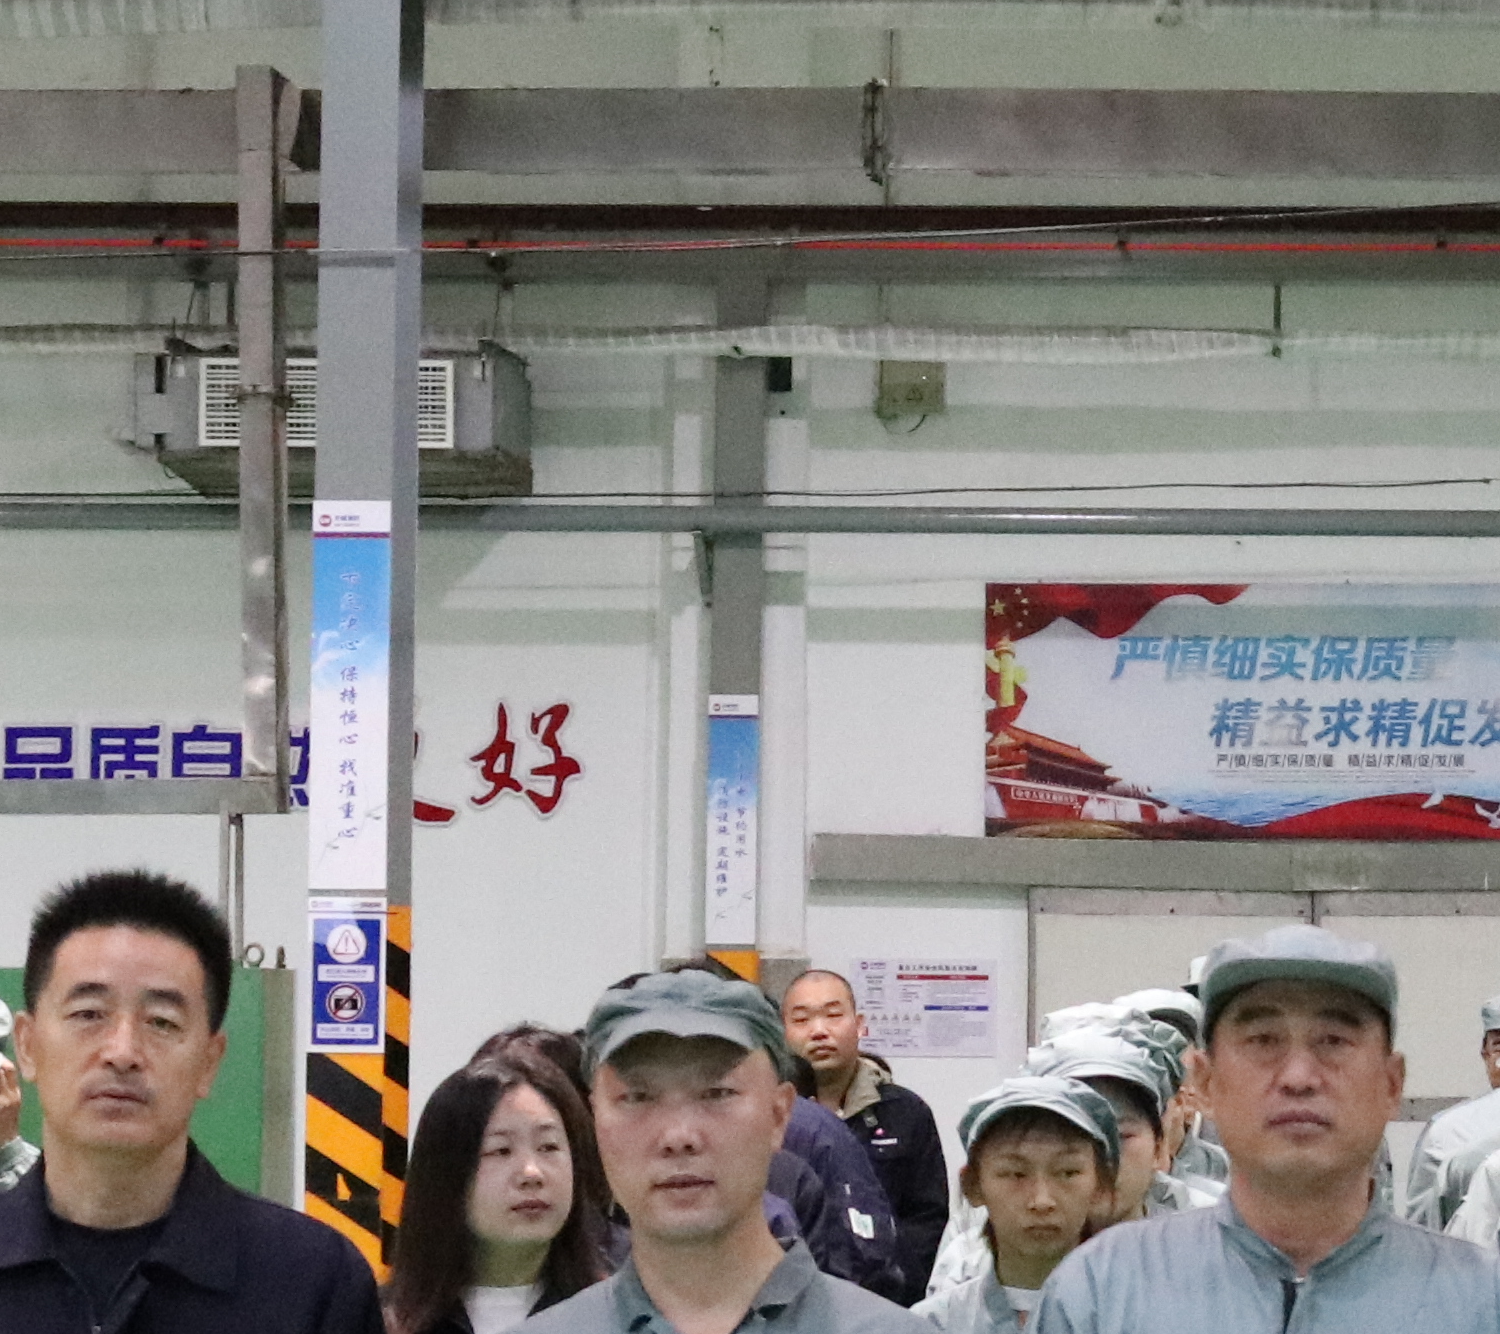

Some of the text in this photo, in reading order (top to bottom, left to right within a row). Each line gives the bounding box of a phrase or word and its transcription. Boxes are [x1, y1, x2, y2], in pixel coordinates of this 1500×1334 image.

[1109, 634, 1457, 682] 严慎细实保质量
